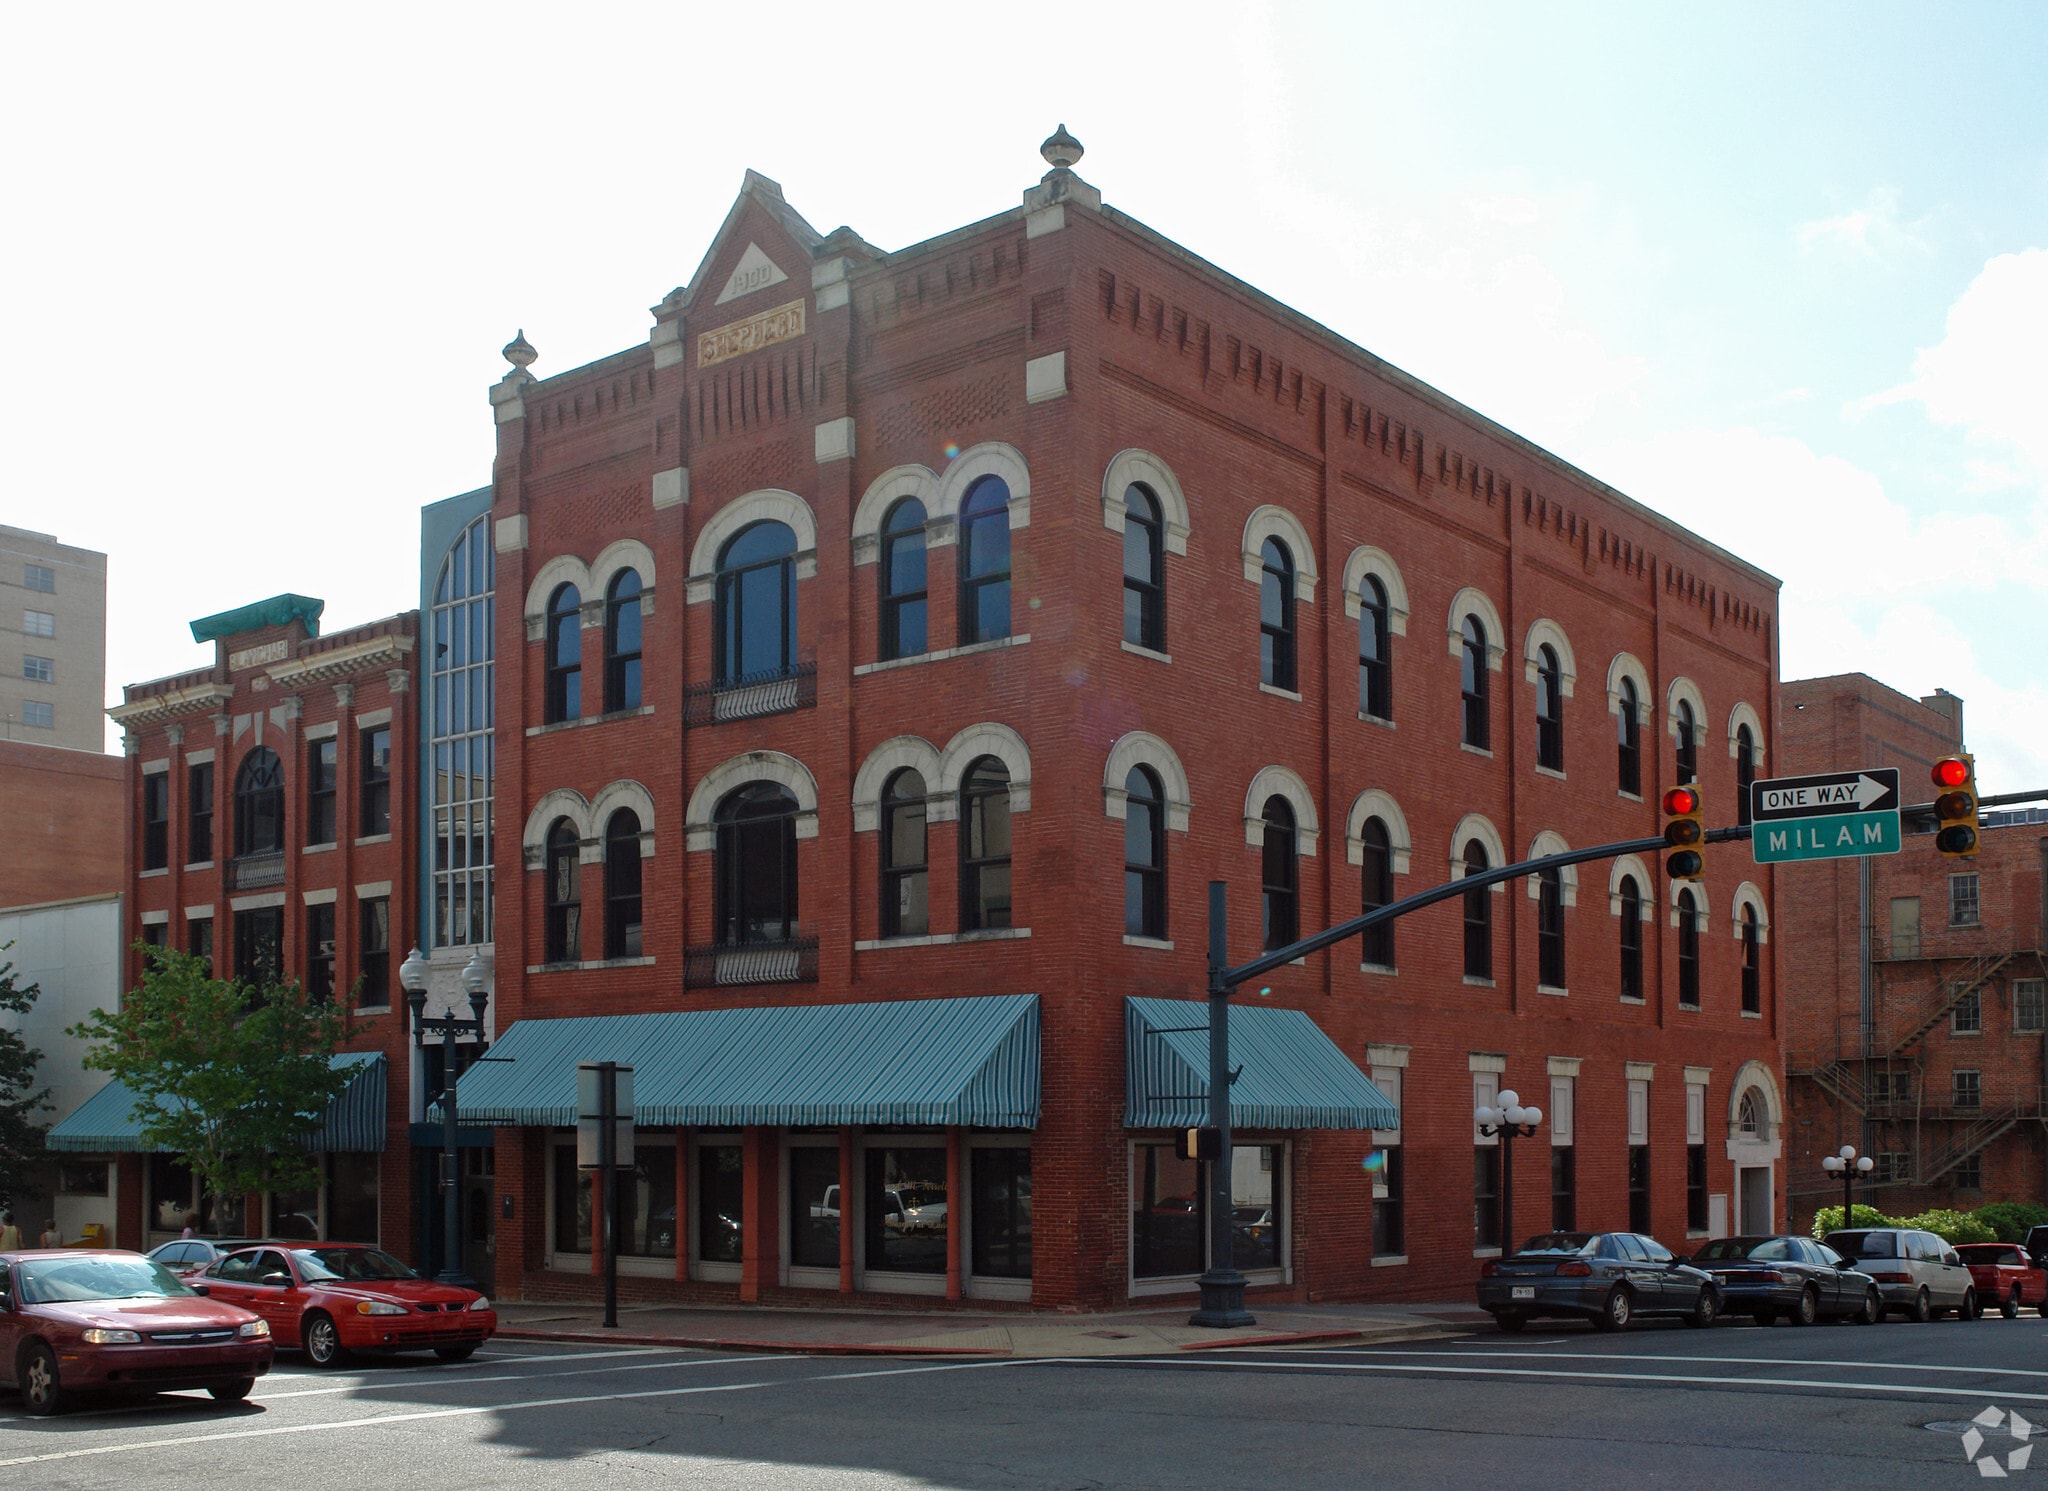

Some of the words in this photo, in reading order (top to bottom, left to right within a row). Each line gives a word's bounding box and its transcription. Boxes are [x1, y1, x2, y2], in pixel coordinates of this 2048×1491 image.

[732, 264, 772, 295] 1900
[1768, 789, 1807, 808] ONE
[1817, 784, 1859, 803] WAY
[1769, 822, 1883, 852] MILAM
